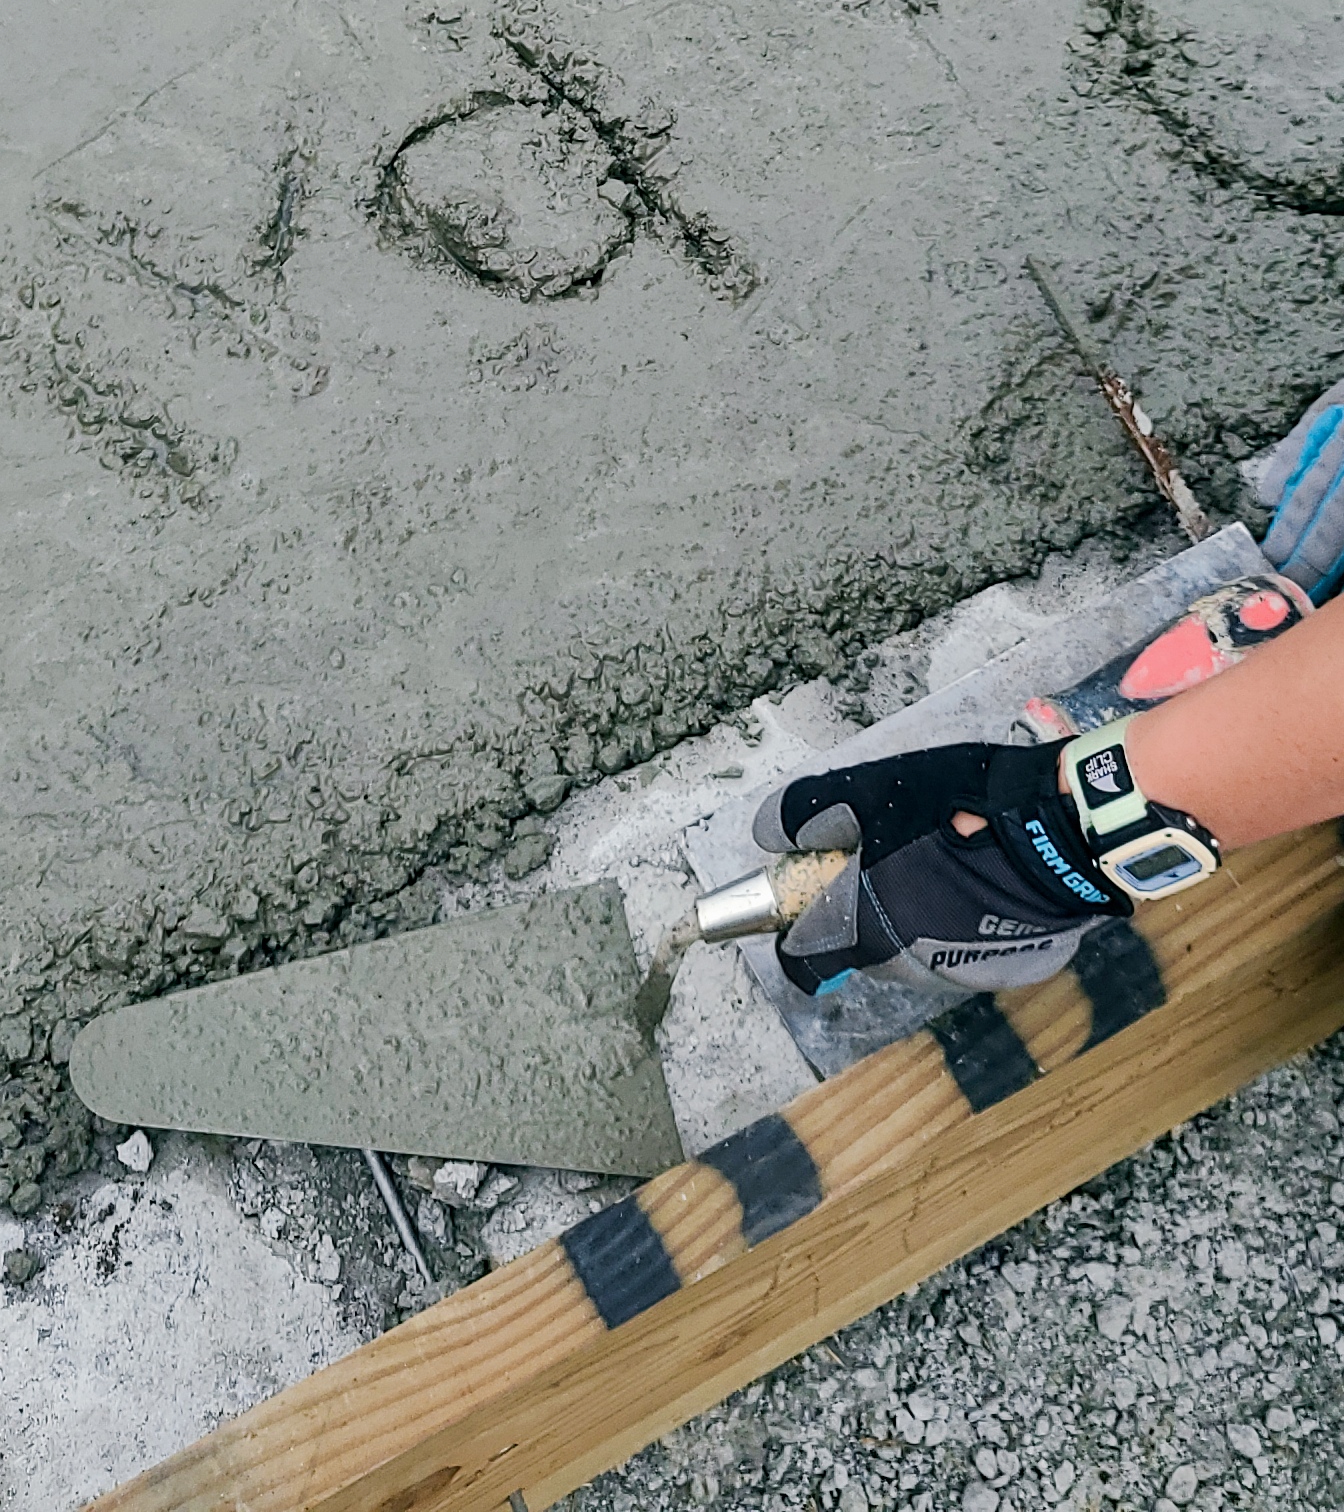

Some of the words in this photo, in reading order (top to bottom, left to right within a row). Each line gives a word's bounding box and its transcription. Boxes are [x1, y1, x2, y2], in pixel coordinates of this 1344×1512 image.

[1085, 750, 1113, 773] CLIP
[1085, 760, 1118, 783] SHARK
[1025, 820, 1071, 874] FIRM
[1062, 872, 1110, 904] GRIP
